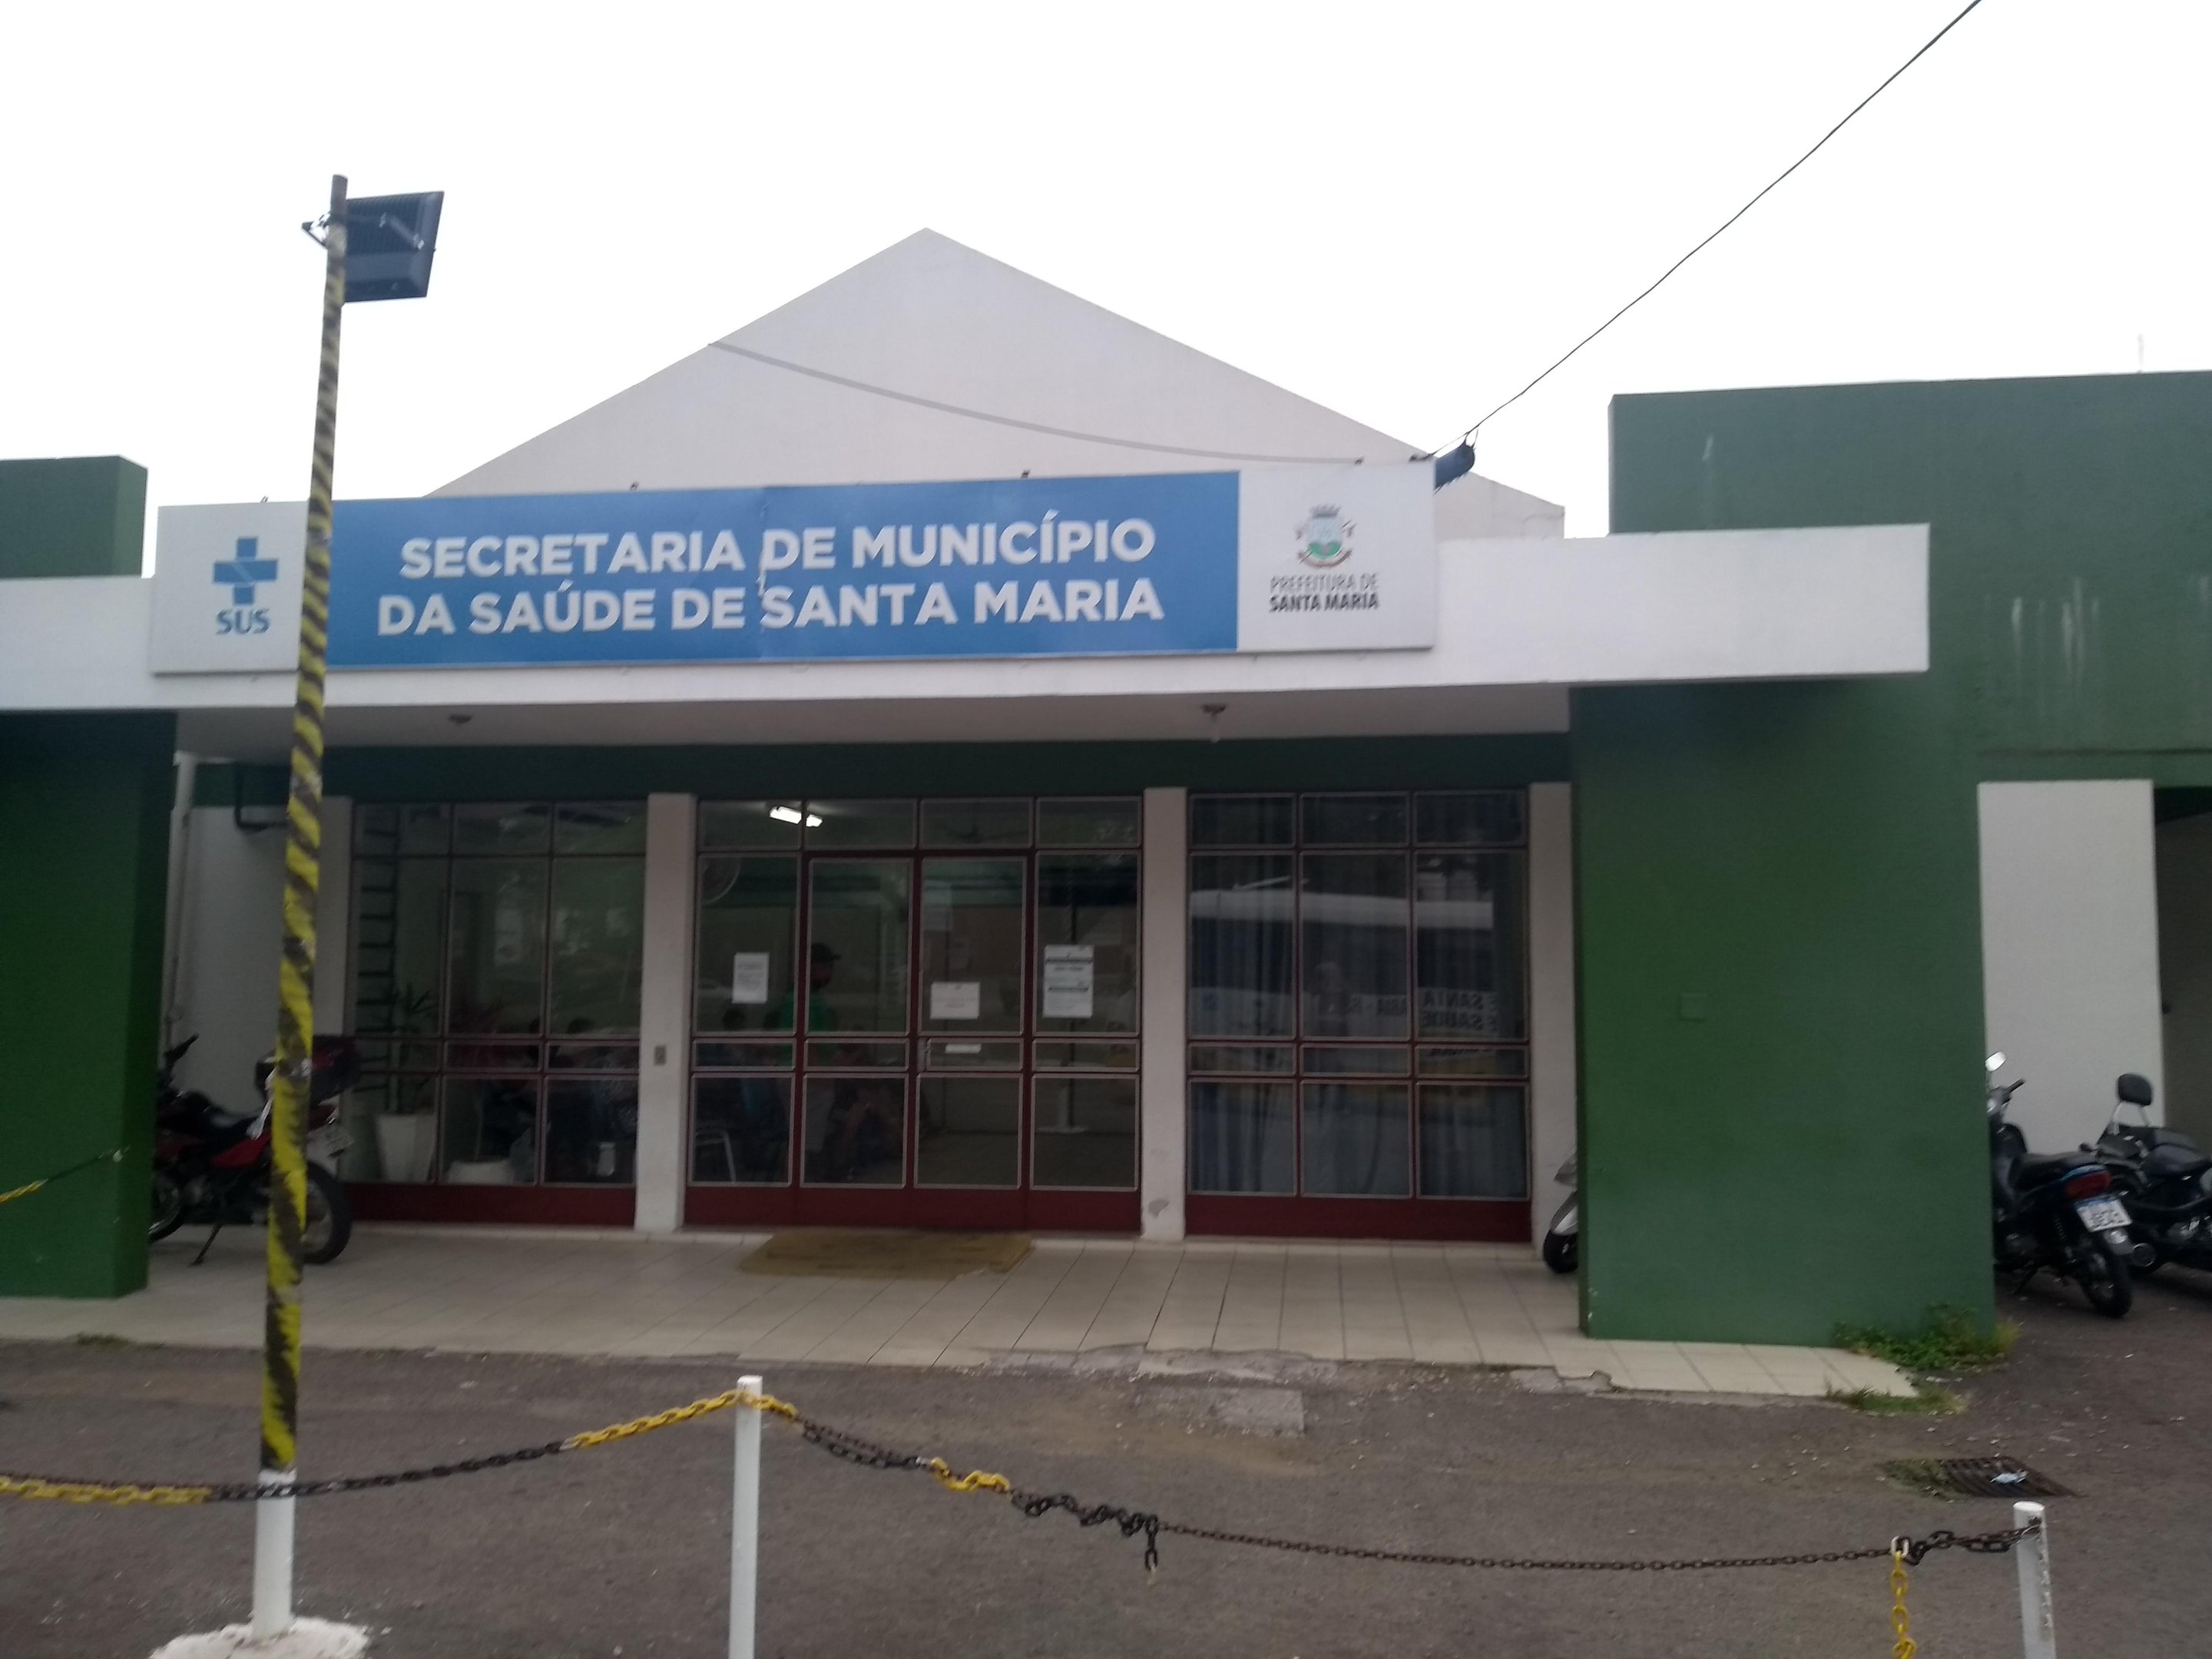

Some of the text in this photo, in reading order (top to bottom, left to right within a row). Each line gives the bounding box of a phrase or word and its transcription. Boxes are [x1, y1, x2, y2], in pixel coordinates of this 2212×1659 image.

[399, 508, 1157, 579] SECRETARIA DE MUNICÍPIO
[1270, 572, 1379, 593] PREFEITURA DE
[377, 577, 1164, 636] DA SAÚDE DE SANTA MARIA
[1269, 591, 1380, 613] SANTA MARIA
[215, 608, 270, 635] SUS
